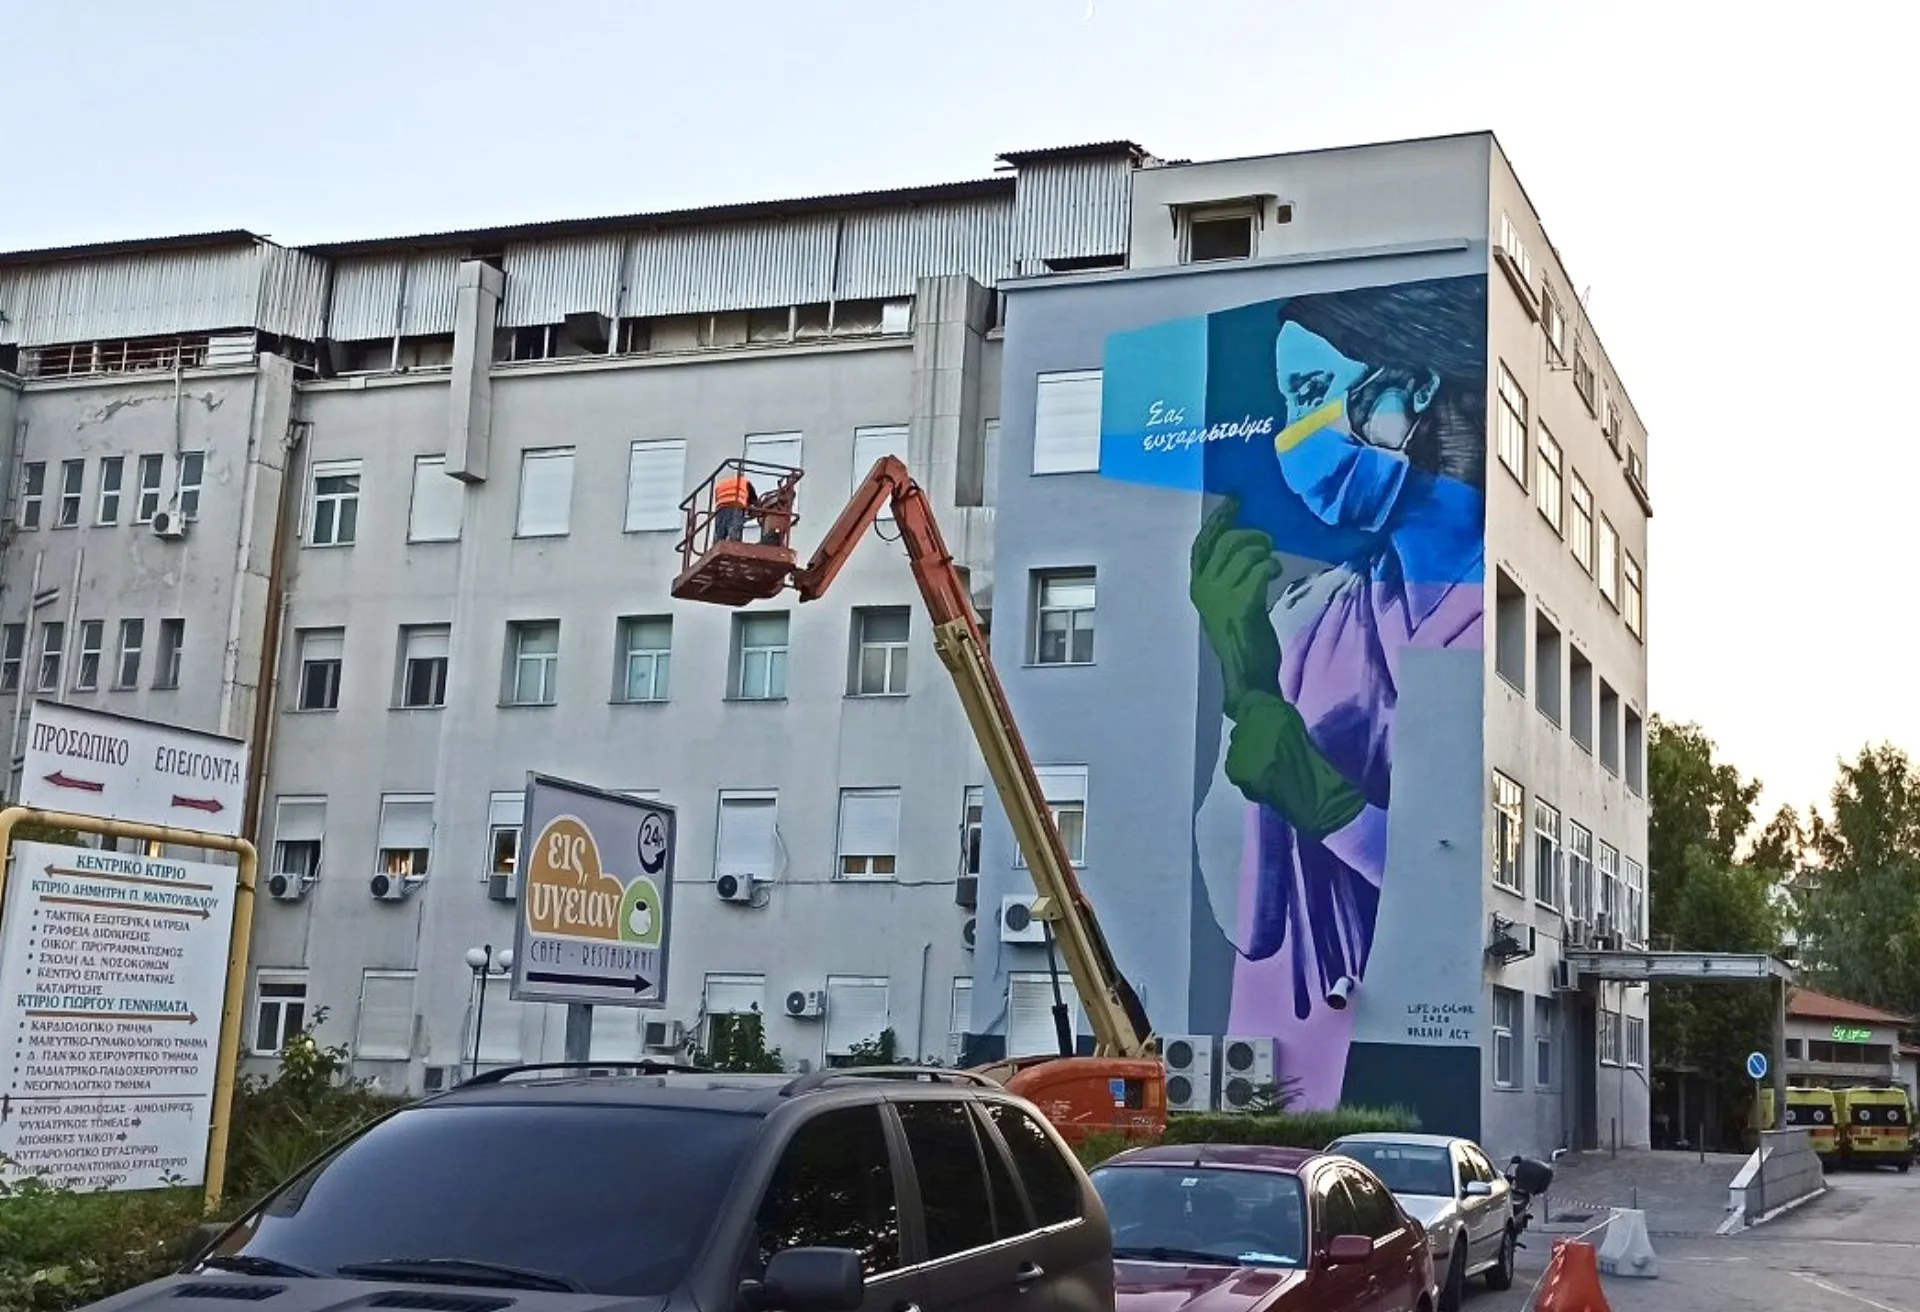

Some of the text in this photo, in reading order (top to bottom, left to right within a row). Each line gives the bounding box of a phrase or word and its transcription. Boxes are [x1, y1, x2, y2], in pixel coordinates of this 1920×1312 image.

[1146, 400, 1185, 426] Σας
[32, 722, 129, 766] ΠΡΟΣΩΠΙΚΟ
[155, 746, 240, 784] ΕΠΕΙΓΟΝΤΑ
[76, 855, 186, 880] ΚΕΝΤΡΙΚΟ ΚΤΙΡΙΟ
[548, 832, 586, 885] εις
[32, 880, 70, 894] ΚΤΙΡΙΟ
[72, 883, 126, 900] ΔΗΜΗΤΡΗ
[43, 924, 90, 937] ΓΡΑΦΕΙΑ
[45, 909, 190, 932] ΤΑΚΤΙΚΑ ΕΞΩΤΕΡΙΚΑ ΙΑΤΡΕΙΑ
[531, 940, 562, 964] CAFE
[37, 967, 81, 980] ΚΕΝΤΡΟ
[36, 983, 103, 996] ΚΑΤΑΡΤΙΣΗΣ
[17, 994, 189, 1013] ΚΤΙΡΙΟ ΓΙΩΡΓΟΥ ΓΕΝΝΗΜΑΤΑ
[20, 1105, 61, 1116] ΚΕΝΤΡΟ
